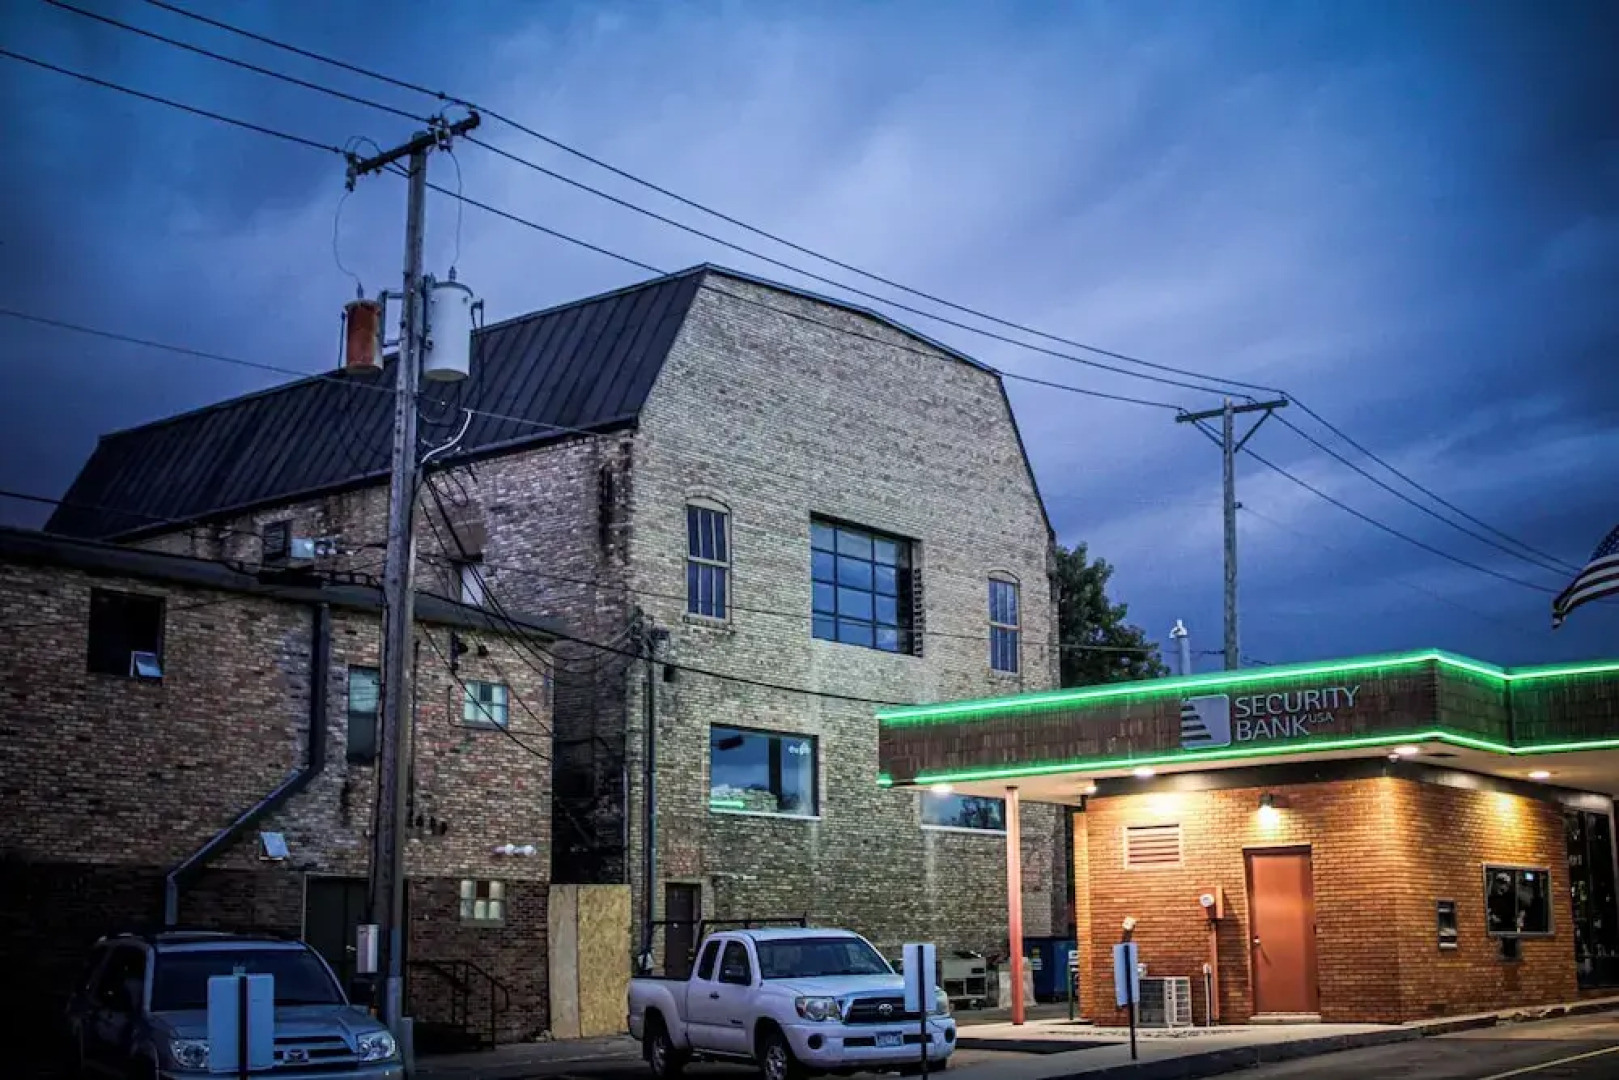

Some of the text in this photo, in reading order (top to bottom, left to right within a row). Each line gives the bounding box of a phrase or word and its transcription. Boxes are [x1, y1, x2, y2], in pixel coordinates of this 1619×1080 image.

[1236, 685, 1360, 718] SECURITY
[1238, 712, 1335, 741] BANK USA
